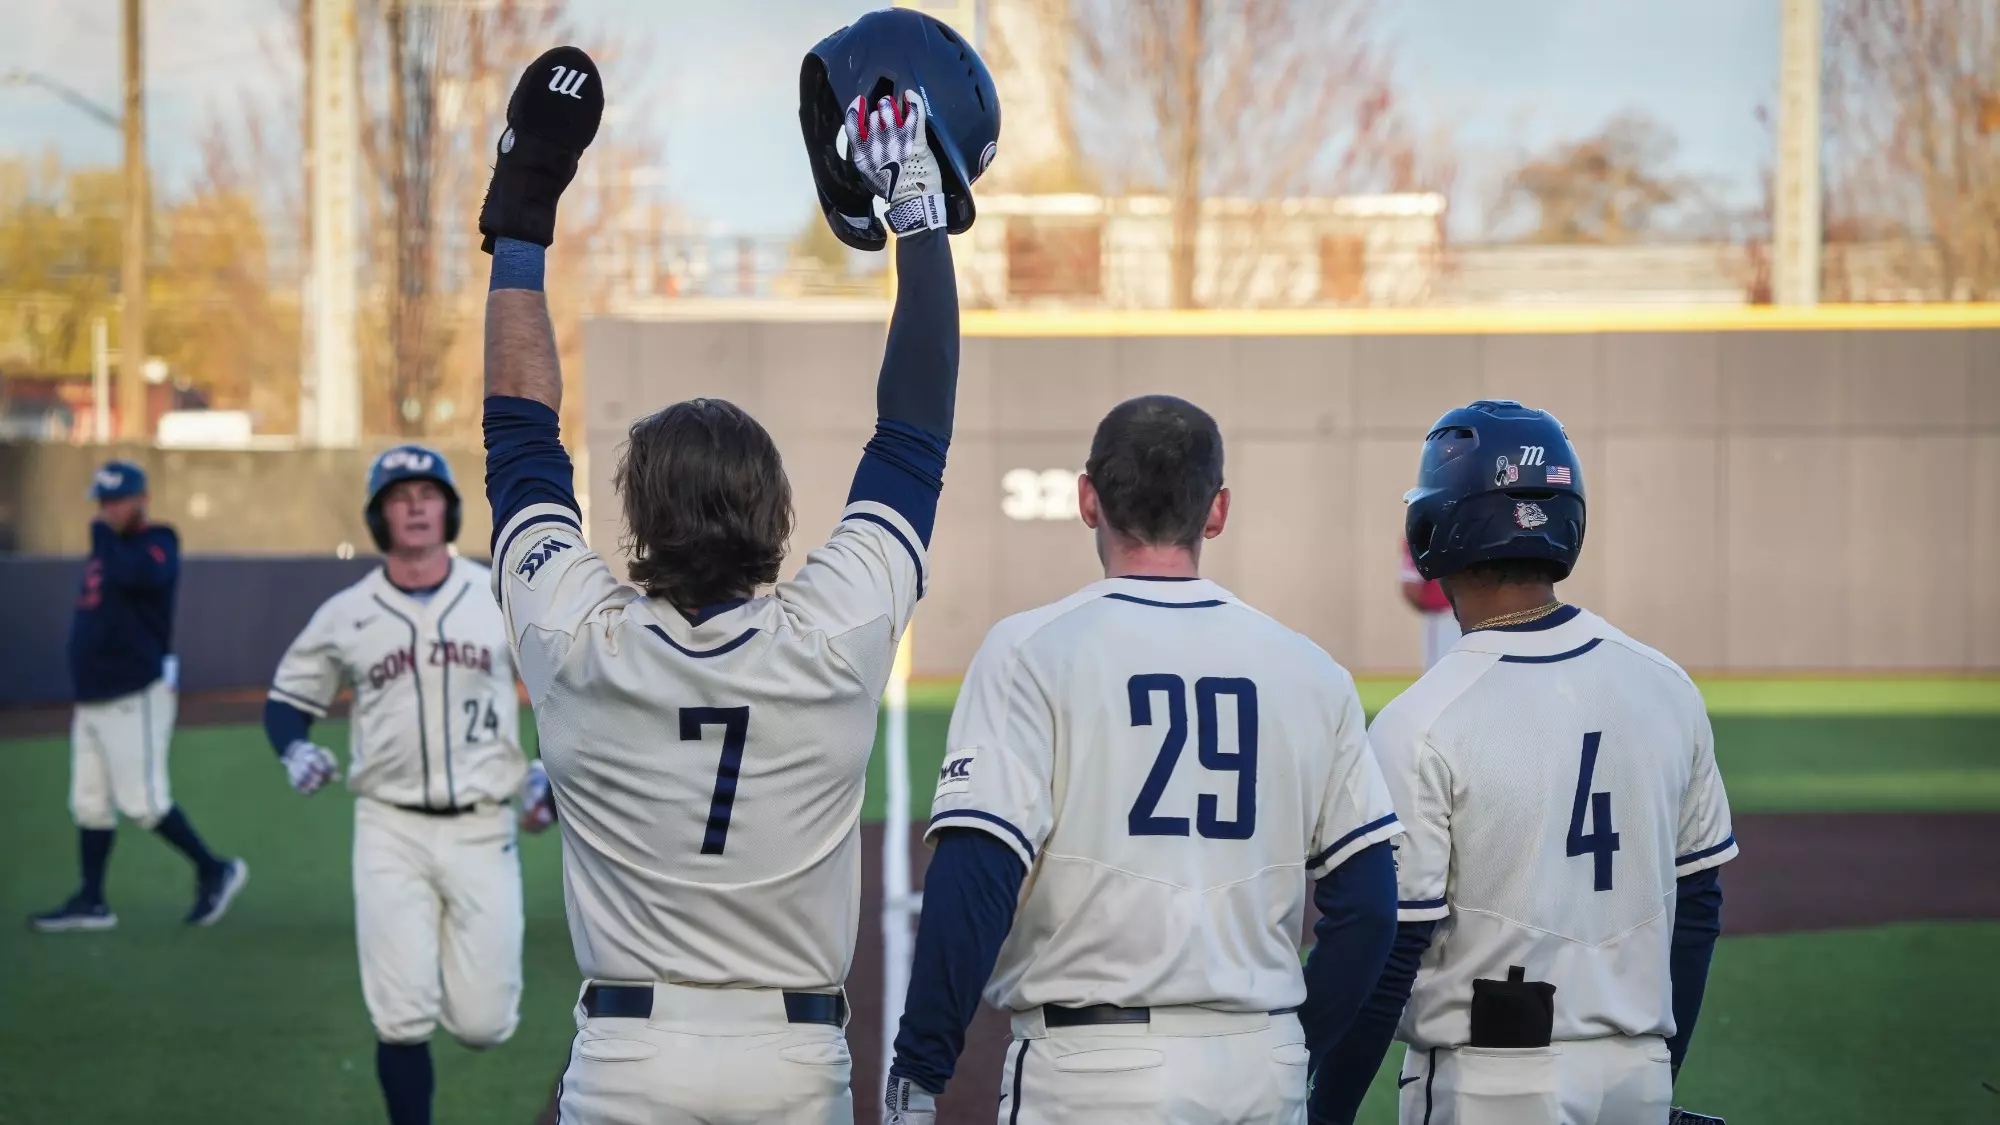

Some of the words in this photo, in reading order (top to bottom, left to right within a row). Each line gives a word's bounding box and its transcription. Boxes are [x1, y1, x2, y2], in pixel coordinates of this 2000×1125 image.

[928, 194, 939, 224] GONZAGA
[1001, 467, 1086, 521] 32
[519, 539, 573, 583] WCC
[369, 641, 491, 690] GONZAGA
[463, 699, 499, 743] 24
[679, 706, 749, 854] 7
[1127, 673, 1258, 839] 29
[1566, 731, 1620, 891] 4
[901, 1081, 911, 1111] GONZAGA
